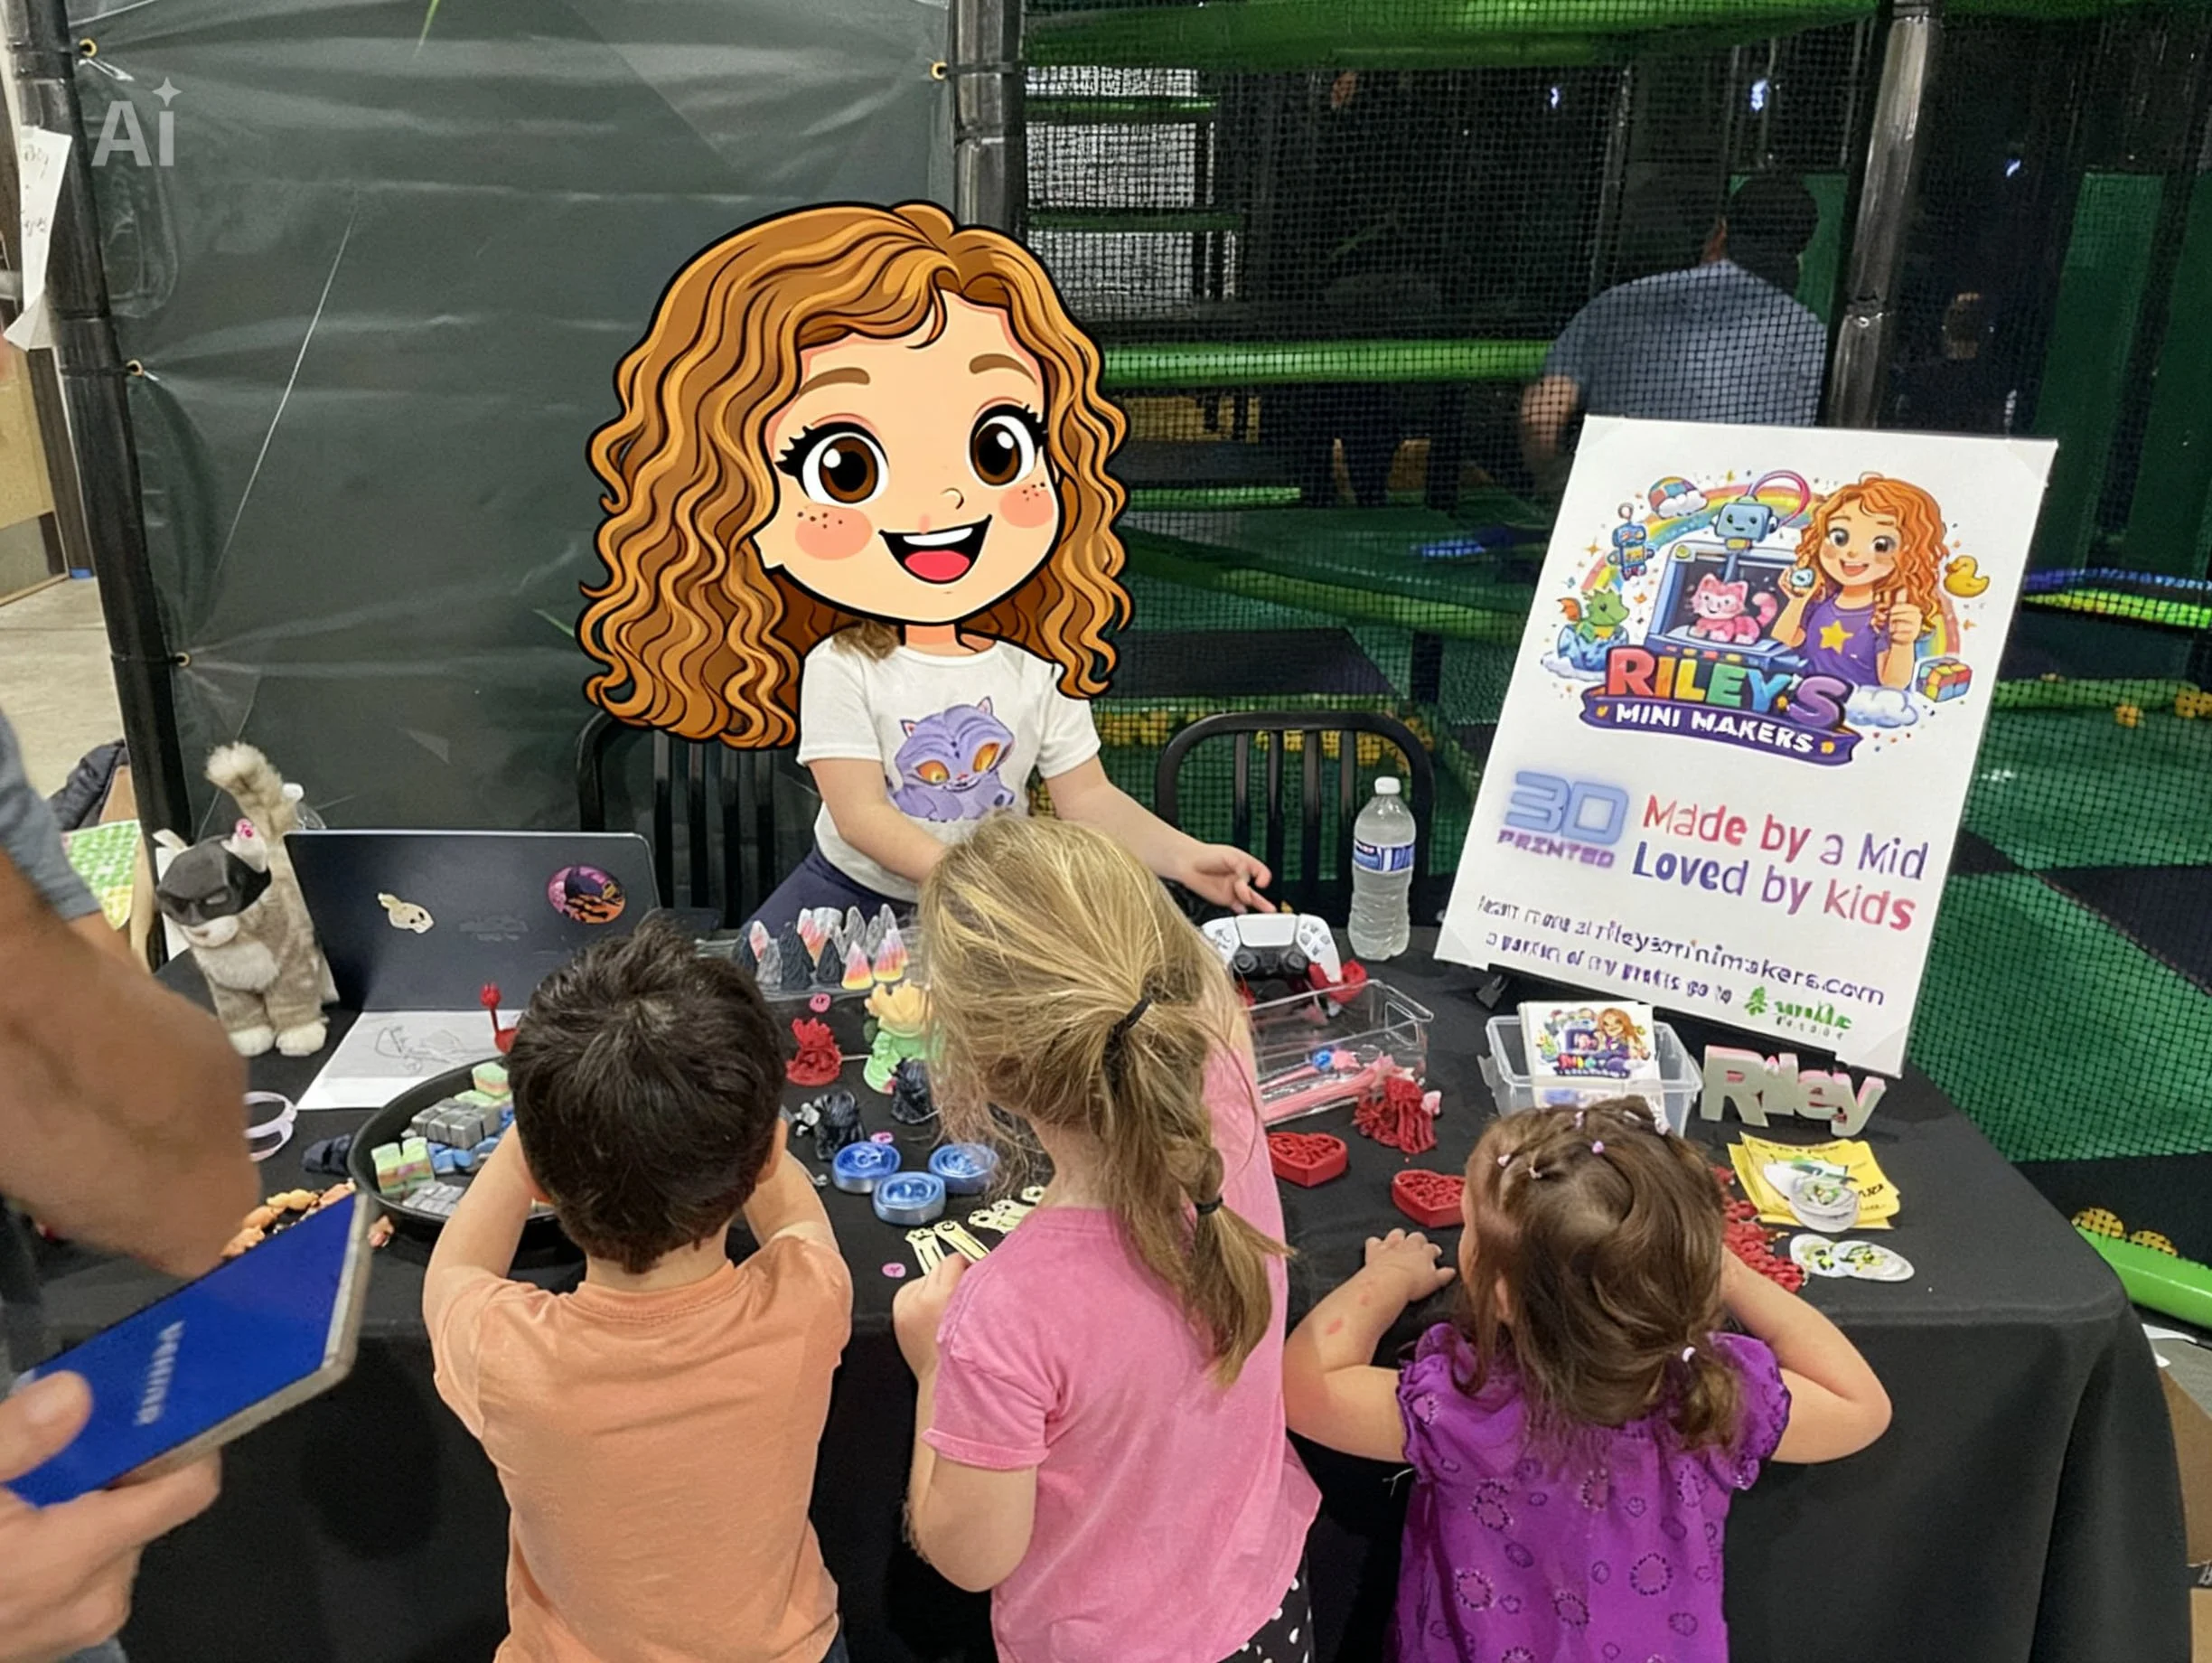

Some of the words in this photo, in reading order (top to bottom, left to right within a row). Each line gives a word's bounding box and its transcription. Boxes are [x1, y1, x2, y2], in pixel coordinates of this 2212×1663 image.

[1616, 703, 1681, 728] MINI
[1692, 711, 1814, 754] MAKERS
[1642, 794, 1748, 846] Made
[1760, 813, 1811, 864] by
[1820, 834, 1844, 866] a
[1632, 841, 1749, 896] Loved
[1761, 864, 1812, 916] by
[1823, 878, 1916, 932] kids
